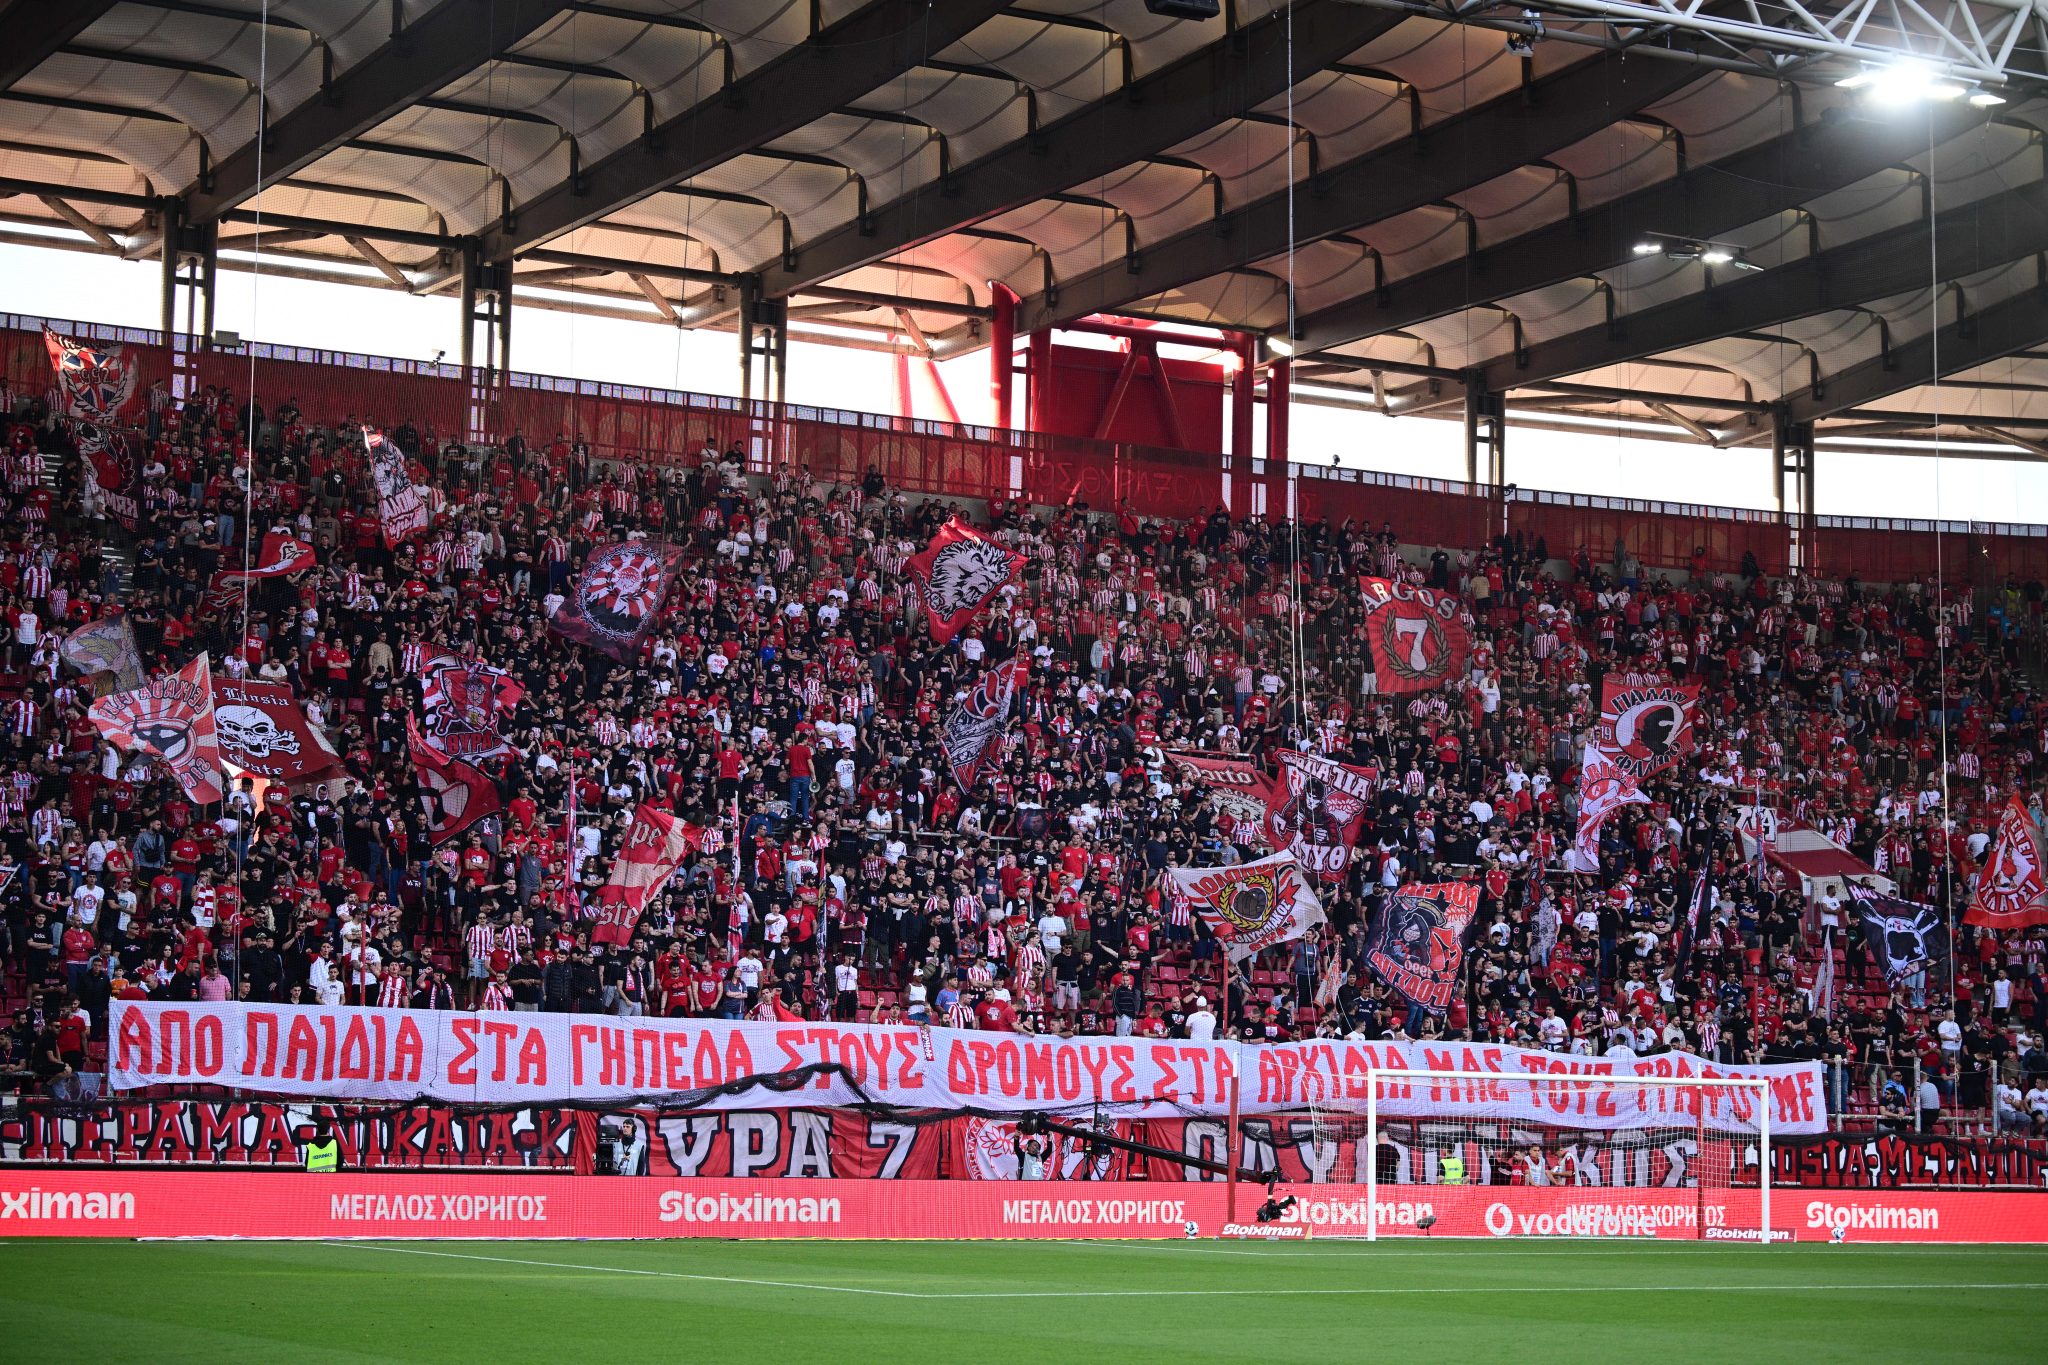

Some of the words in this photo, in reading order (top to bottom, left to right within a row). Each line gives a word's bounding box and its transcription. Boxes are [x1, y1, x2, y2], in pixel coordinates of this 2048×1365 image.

[1362, 581, 1457, 619] ARGOS
[1395, 618, 1428, 671] 7
[116, 1005, 223, 1077] ΑΠΟ
[242, 1011, 423, 1082] ΠΑΙΔΙΑ
[448, 1018, 547, 1086] ΣΤΑ
[572, 1025, 754, 1090] ΓΗΠΕΔΑ
[776, 1028, 924, 1091] ΣΤΟΥΣ
[1151, 1045, 1235, 1104] ΣΤΑ
[1424, 1048, 1509, 1104] ΜΑΣ
[1521, 1055, 1616, 1117] ΤΟΥΣ
[867, 1121, 918, 1179] 7
[331, 1194, 436, 1221] ΜΕΓΑΛΟΣ
[440, 1194, 547, 1221] ΧΟΡΗΓΟΣ
[659, 1190, 841, 1223] Stoiximan
[1003, 1199, 1092, 1224] ΜΕΓΑΛΟΣ
[1096, 1199, 1185, 1224] ΧΟΡΗΓΟΣ
[1280, 1196, 1433, 1227] Stoiximan
[1807, 1201, 1939, 1230] Stoiximan
[1222, 1223, 1304, 1237] Stoiximan
